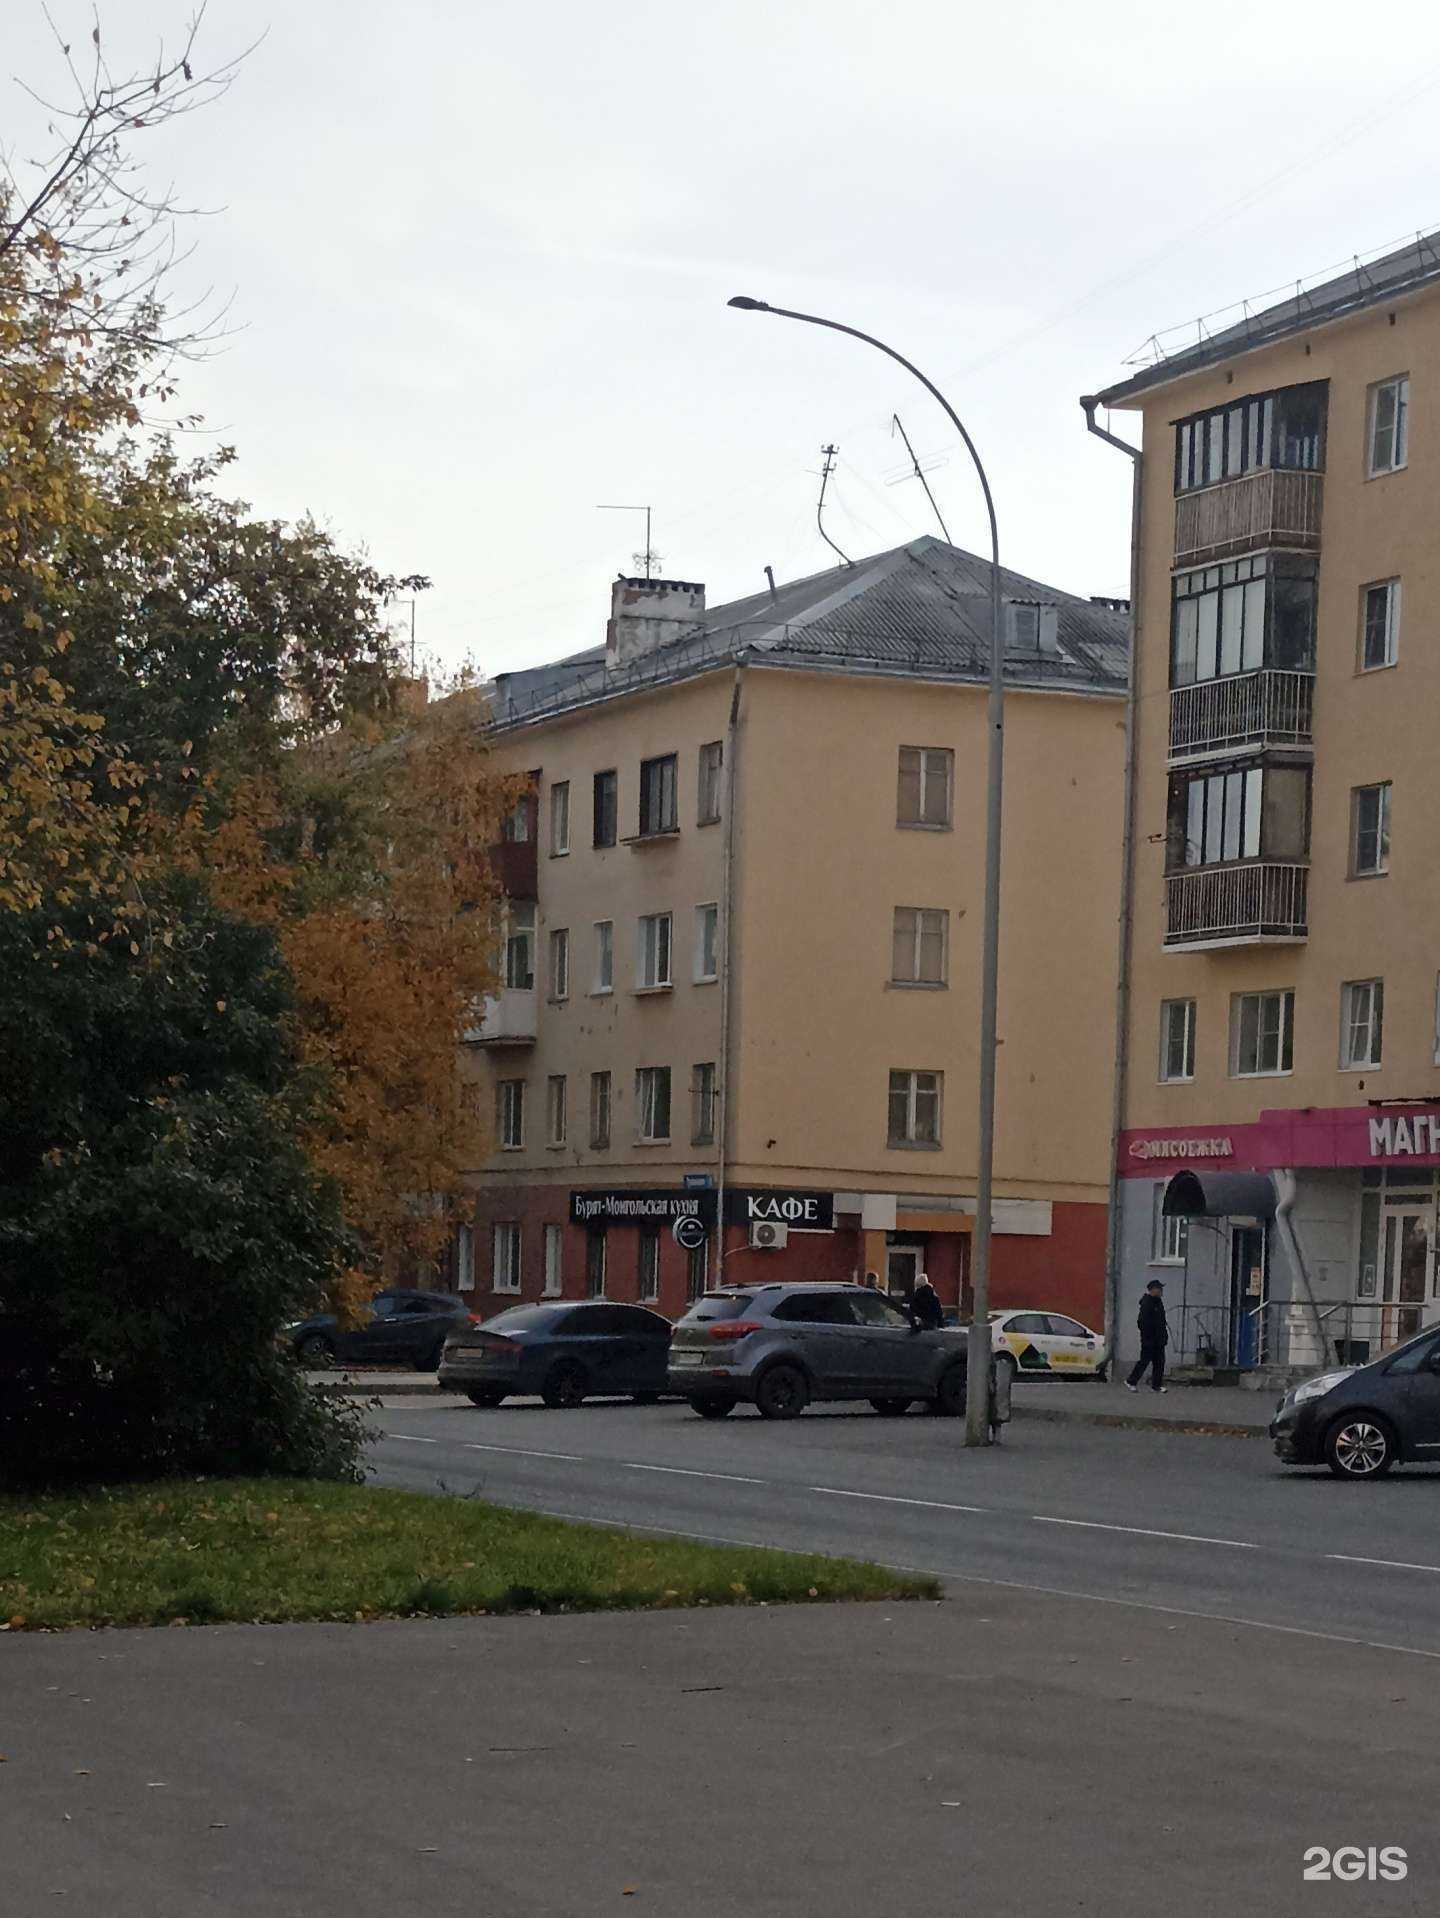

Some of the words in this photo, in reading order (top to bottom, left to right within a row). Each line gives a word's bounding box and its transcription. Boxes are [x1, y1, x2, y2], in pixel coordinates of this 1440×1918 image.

[575, 1196, 668, 1219] Бурят-Монгольская
[670, 1199, 699, 1217] кухня
[747, 1196, 818, 1220] КАФЕ
